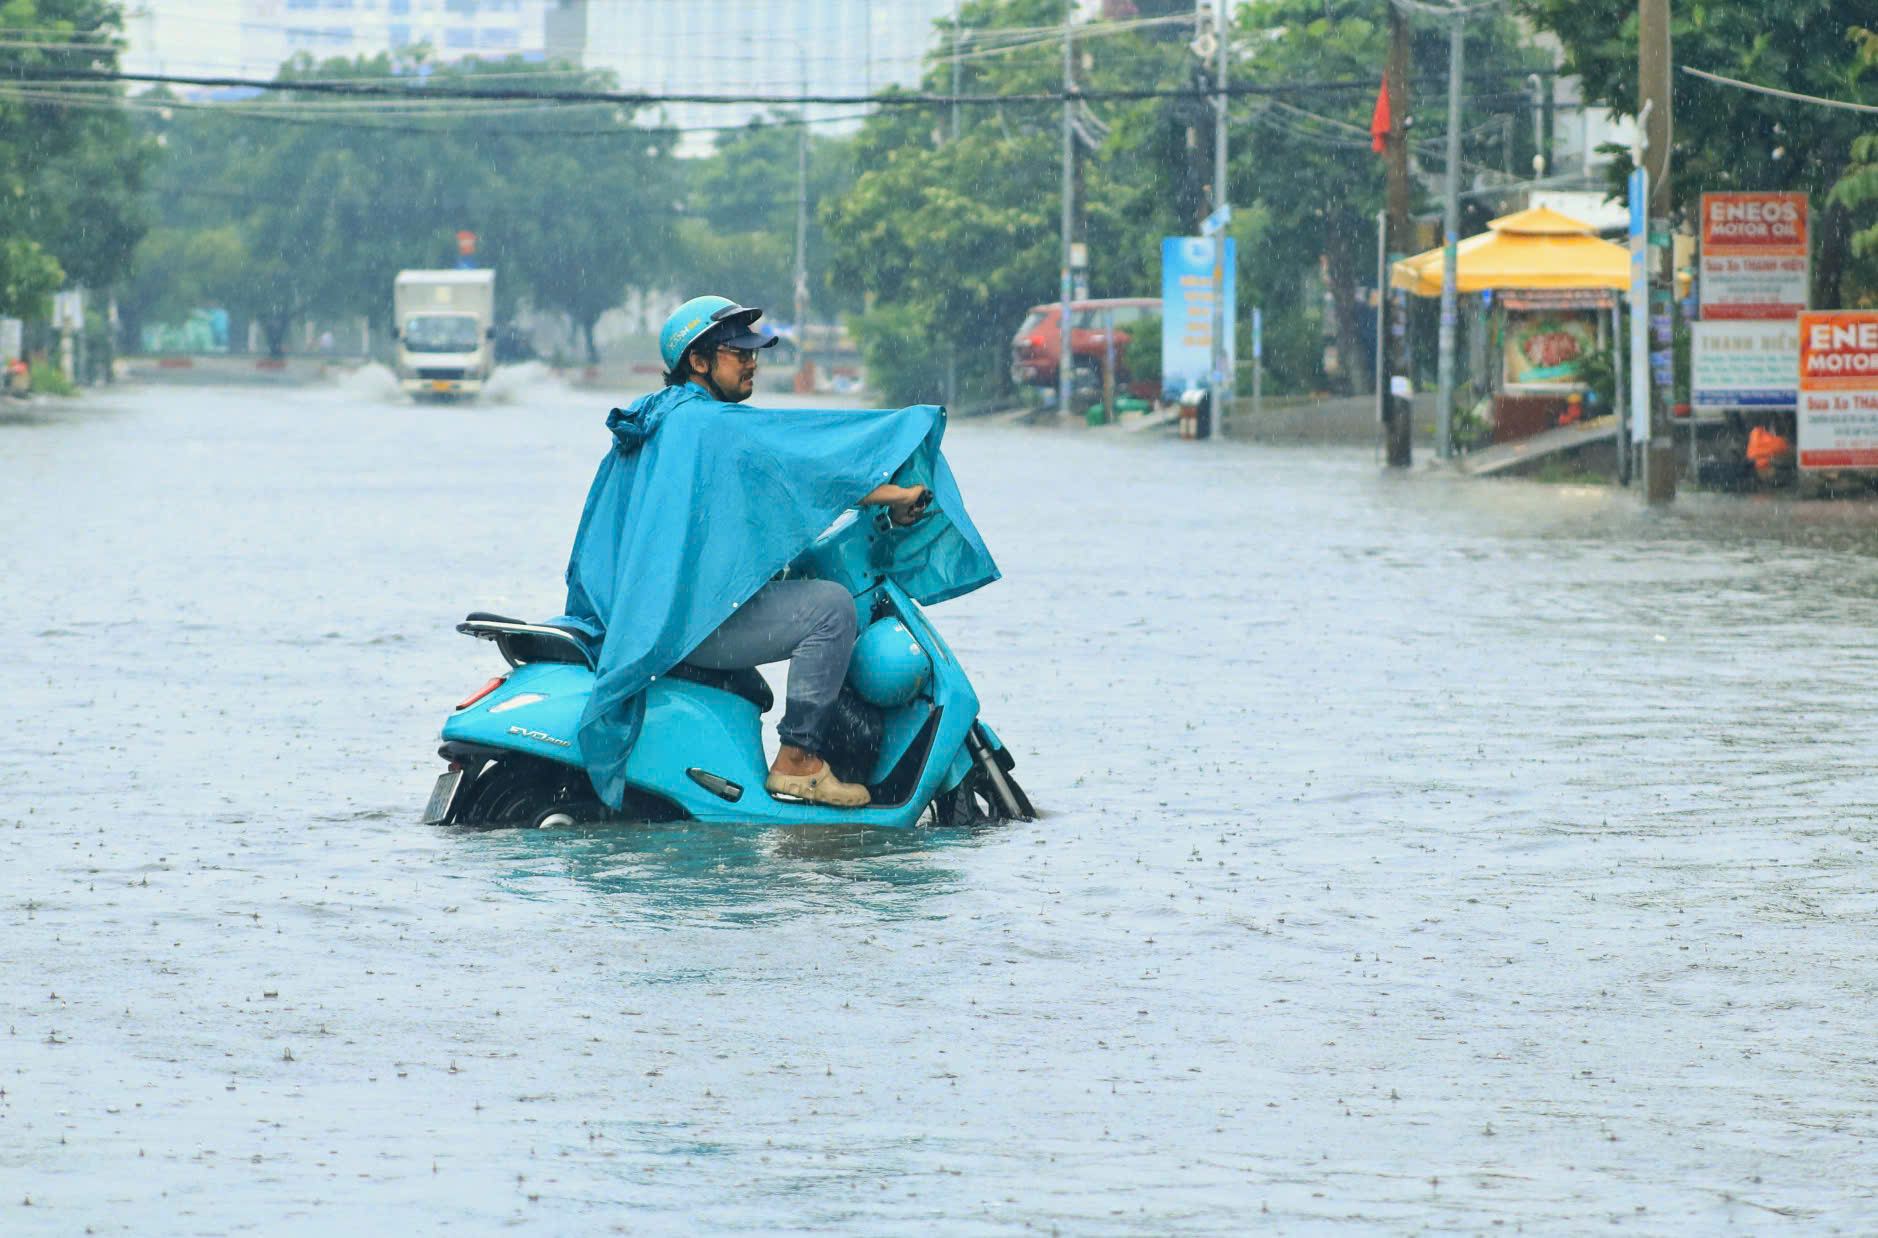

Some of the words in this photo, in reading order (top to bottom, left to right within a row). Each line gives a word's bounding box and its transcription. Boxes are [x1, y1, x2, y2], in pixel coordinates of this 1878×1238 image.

[1710, 201, 1798, 221] ENEOS
[1710, 223, 1768, 237] MOTOR
[1771, 223, 1797, 237] OIL
[1811, 324, 1878, 348] ENE
